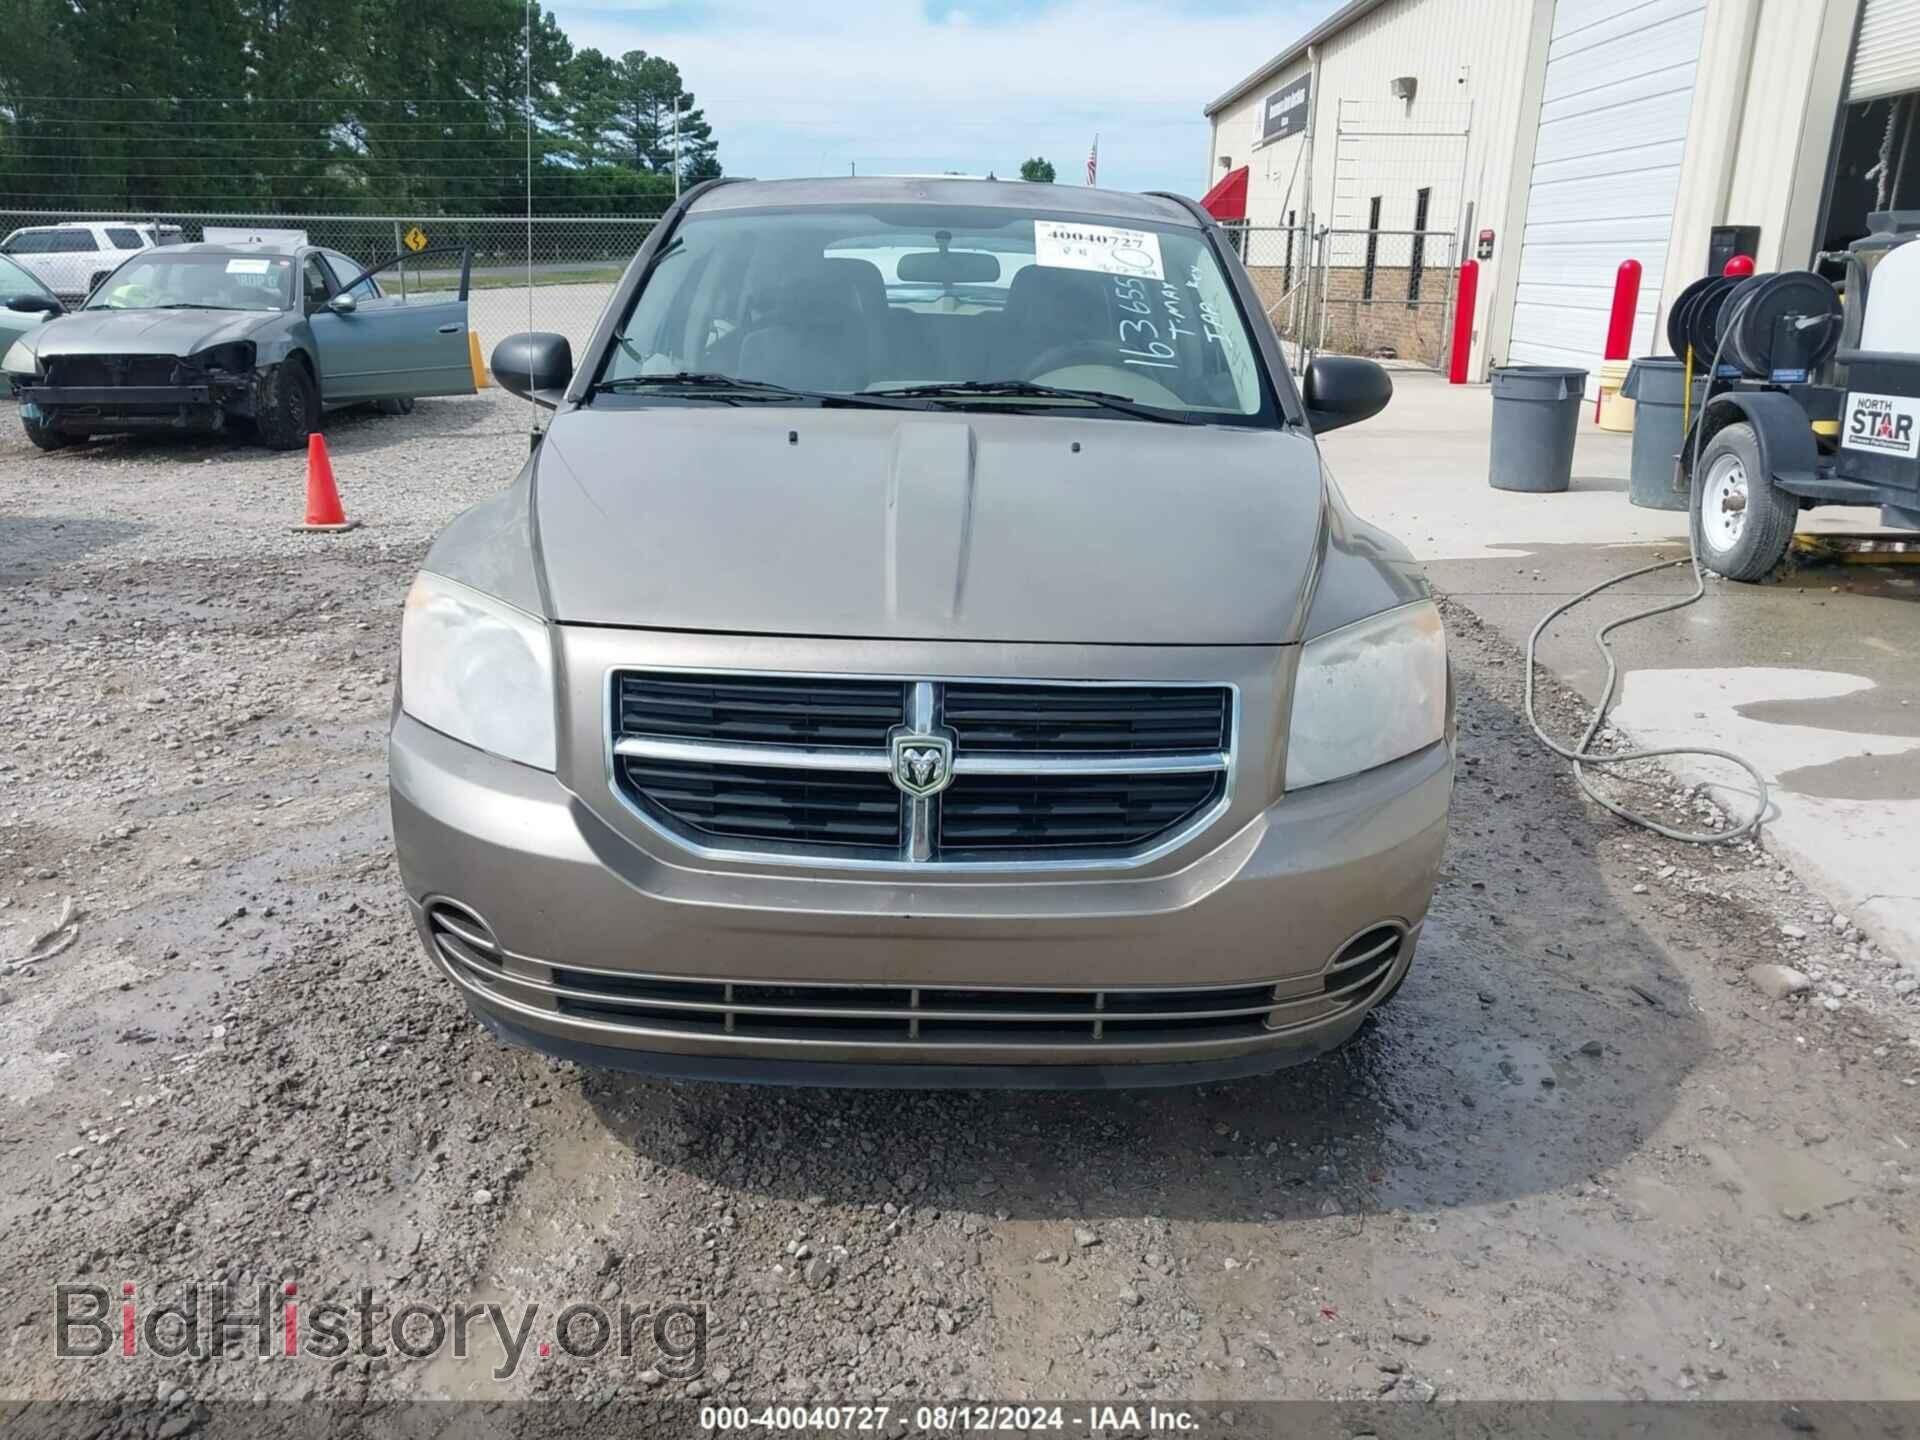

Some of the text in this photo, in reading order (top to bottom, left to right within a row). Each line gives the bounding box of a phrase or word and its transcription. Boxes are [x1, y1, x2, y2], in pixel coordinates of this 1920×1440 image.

[1048, 231, 1142, 248] 40040727
[1114, 276, 1180, 369] 163655
[1857, 397, 1893, 411] NORTH
[1850, 409, 1913, 441] STAR
